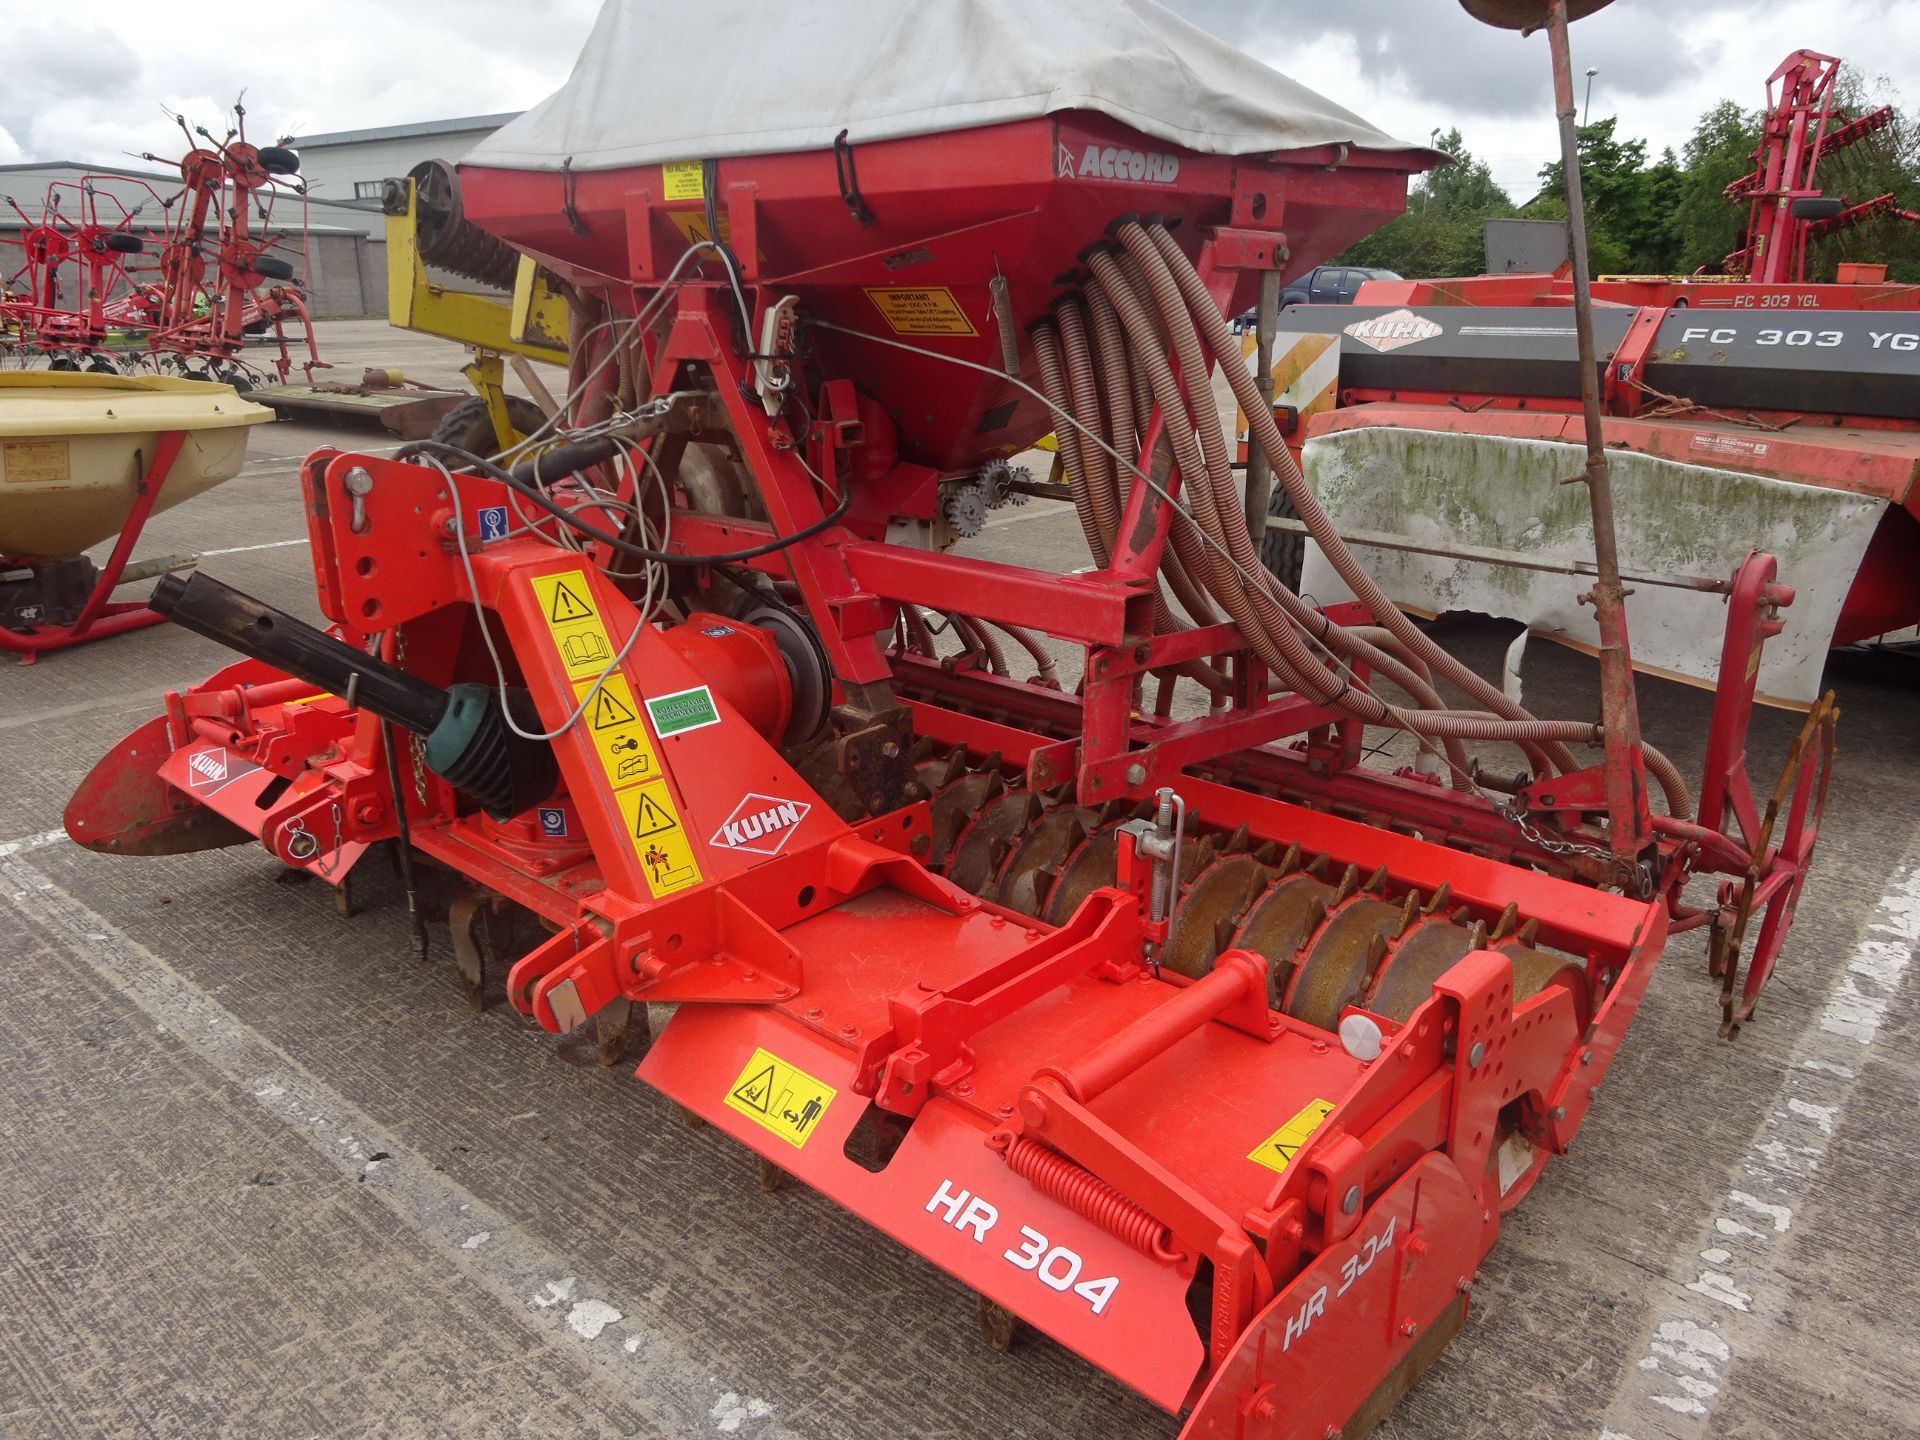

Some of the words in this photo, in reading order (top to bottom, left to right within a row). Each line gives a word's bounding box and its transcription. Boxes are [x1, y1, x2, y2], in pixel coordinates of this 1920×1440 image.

[1078, 145, 1179, 182] ACCORD
[1734, 295, 1755, 307] FC
[1760, 295, 1790, 307] 303
[1797, 295, 1820, 307] YGL
[1354, 321, 1436, 339] KUHN
[1681, 328, 1736, 344] FC
[1755, 329, 1843, 347] 303
[1721, 440, 1754, 448] TRACTORS
[656, 703, 681, 714] ROBERT
[683, 697, 705, 708] DAVIES
[658, 706, 696, 721] MACHINERY
[698, 704, 709, 712] LTD
[191, 753, 226, 780] KUHN
[722, 801, 800, 847] KUHN
[924, 1178, 999, 1244] HR
[1003, 1224, 1120, 1316] 304
[1283, 1285, 1328, 1352] HR
[1336, 1215, 1396, 1298] 304
